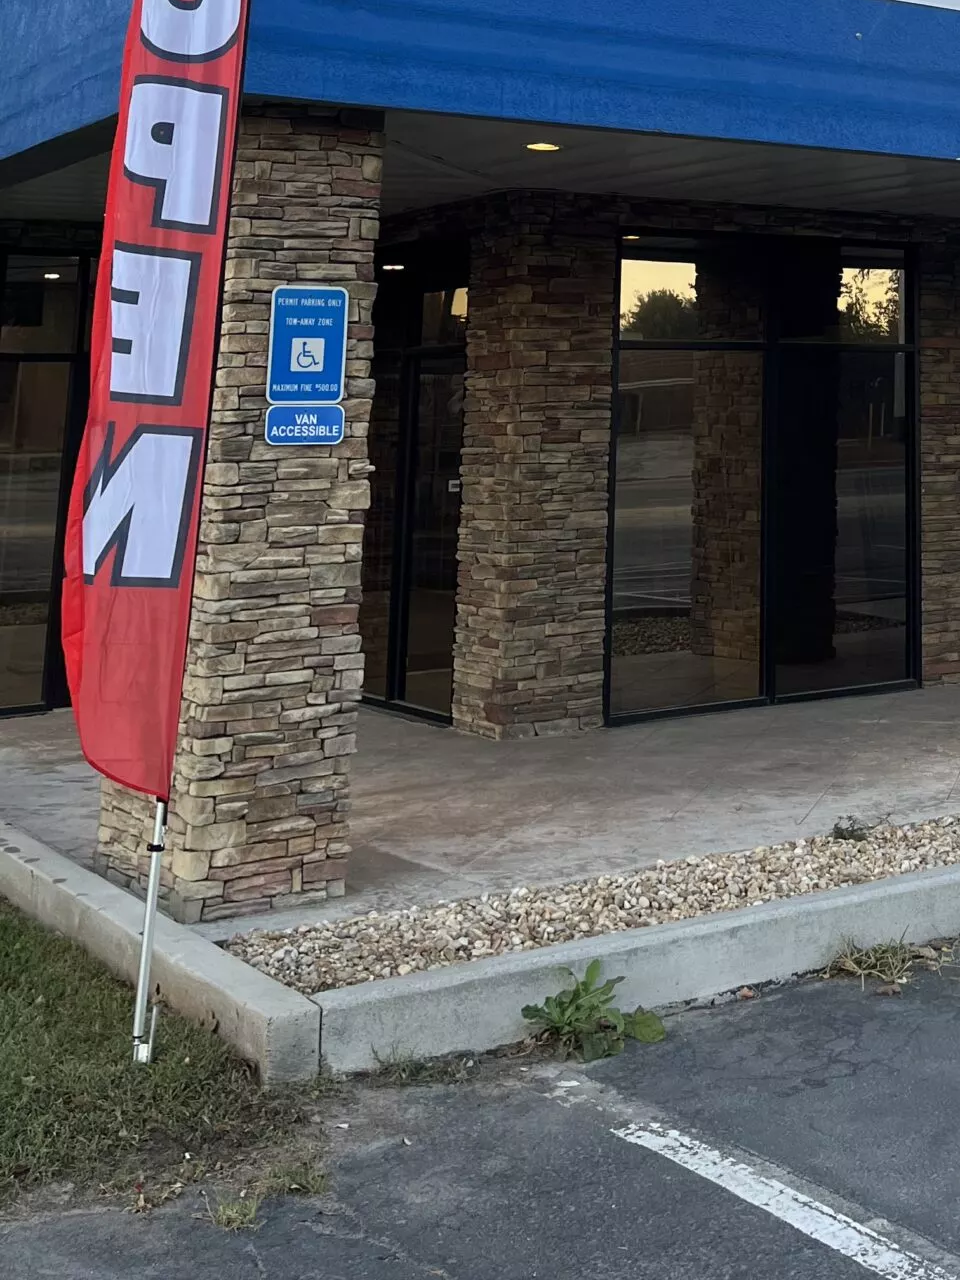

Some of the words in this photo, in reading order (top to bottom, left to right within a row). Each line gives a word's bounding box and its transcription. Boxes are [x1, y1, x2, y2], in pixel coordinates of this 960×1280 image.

[277, 297, 299, 306] PERMIT
[300, 298, 326, 307] PARKING
[327, 299, 343, 307] ONLY
[285, 317, 316, 326] TOW-AWAY
[317, 318, 334, 327] ZONE
[272, 383, 299, 392] MAXIMUM
[300, 383, 313, 392] FINE
[294, 413, 318, 425] VAN
[270, 425, 340, 437] ACCESSIBLE
